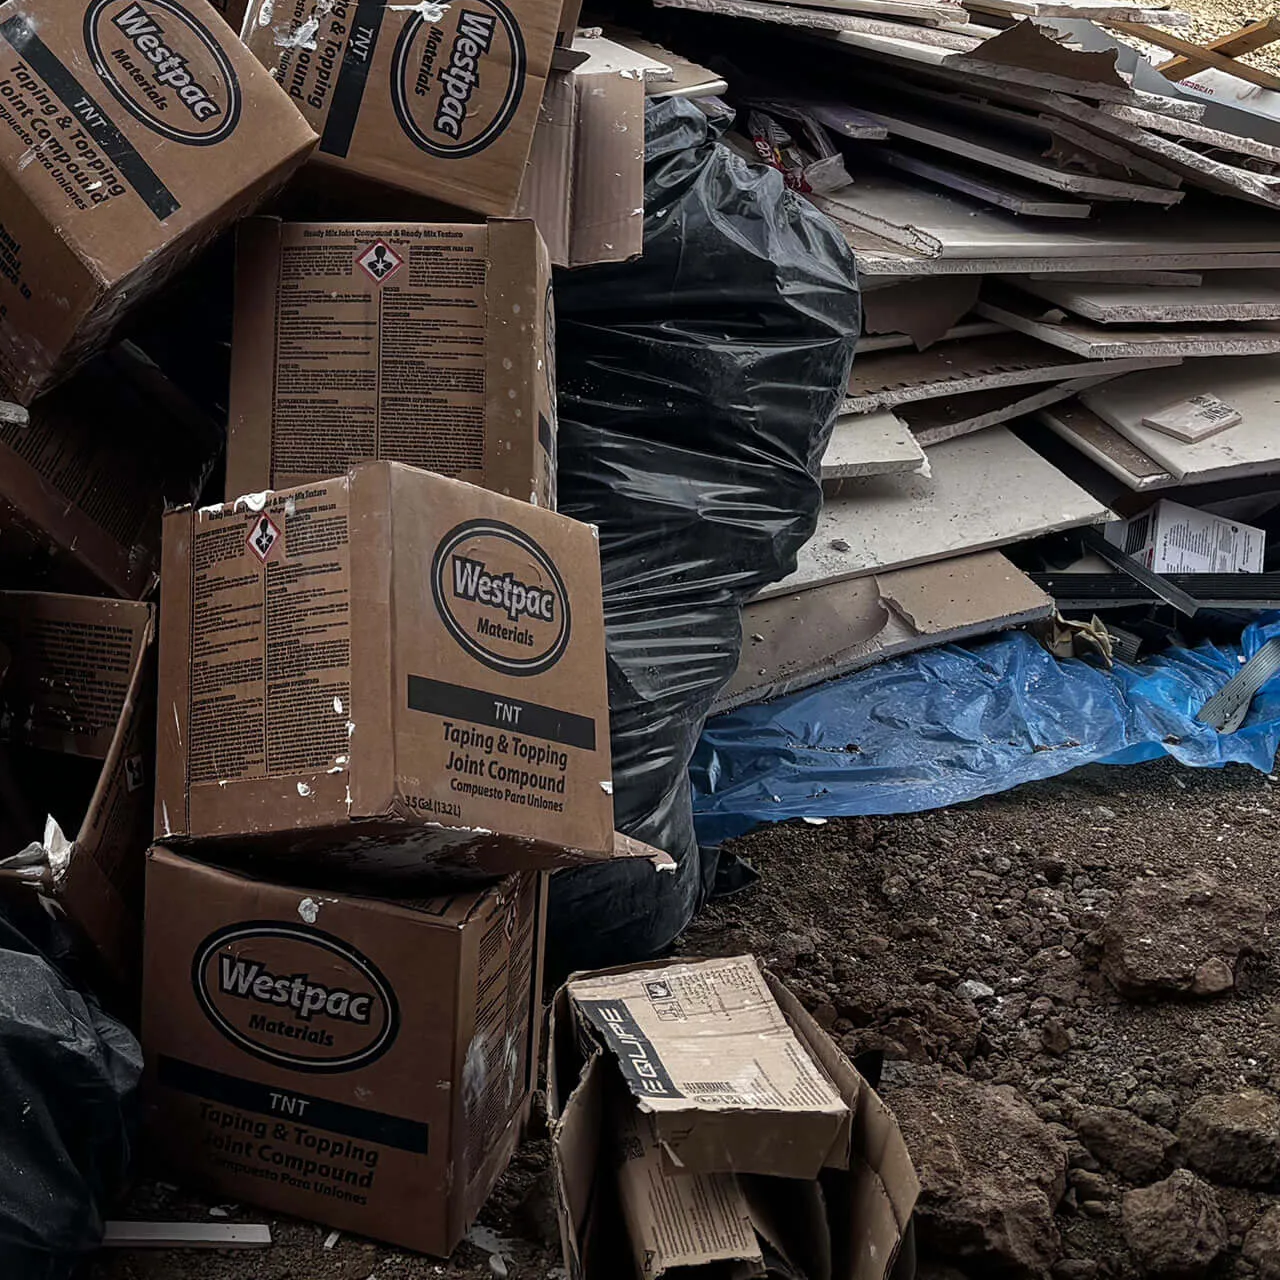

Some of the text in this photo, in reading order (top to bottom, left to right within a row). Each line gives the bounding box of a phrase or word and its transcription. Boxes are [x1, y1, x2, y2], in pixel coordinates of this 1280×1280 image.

[330, 25, 346, 35] &
[358, 25, 374, 62] TNT
[111, 49, 168, 110] Materials
[113, 3, 219, 120] Westpac
[308, 40, 342, 109] Topping
[415, 26, 444, 96] Materials
[435, 10, 495, 138] Westpac
[10, 61, 126, 197] Taping & Topping
[74, 97, 107, 128] TNT
[30, 118, 110, 204] Compound
[33, 144, 54, 170] Para
[51, 169, 87, 210] Uniones
[304, 230, 324, 238] Ready
[355, 230, 392, 239] Compound
[400, 230, 423, 239] Ready
[423, 230, 437, 238] Mix
[437, 230, 463, 238] Texture
[454, 557, 553, 620] Westpac
[477, 617, 534, 647] Materials
[494, 701, 522, 724] TNT
[443, 722, 568, 770] Taping & Topping
[446, 751, 565, 794] Joint Compound
[450, 778, 563, 812] Compuesto Para Uniones
[404, 795, 418, 809] 3.5
[418, 795, 433, 812] Gal.
[222, 956, 372, 1022] Westpac
[249, 1014, 335, 1047] Materials
[598, 1008, 668, 1094] EQUIPE
[270, 1093, 310, 1117] TNT
[199, 1102, 379, 1167] Taping & Topping
[204, 1131, 375, 1188] Joint Compound
[280, 1172, 368, 1206] Para Uniones
